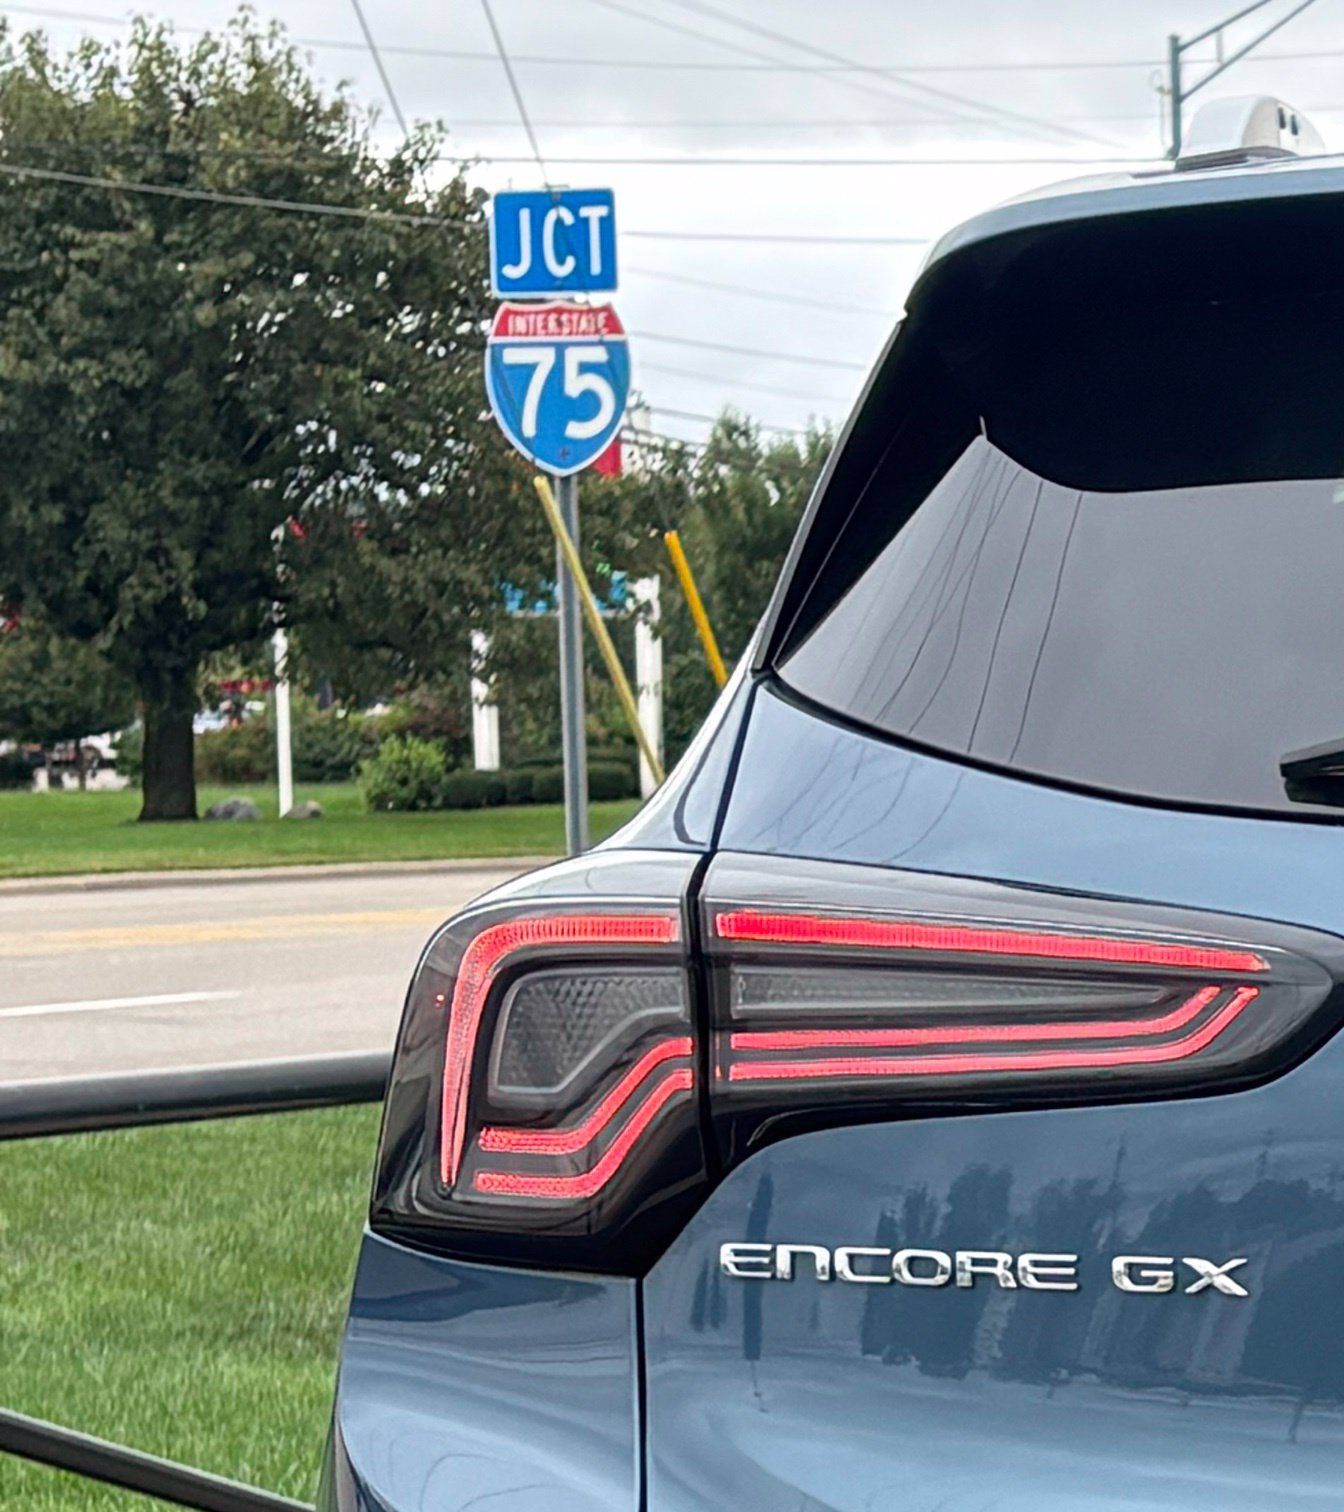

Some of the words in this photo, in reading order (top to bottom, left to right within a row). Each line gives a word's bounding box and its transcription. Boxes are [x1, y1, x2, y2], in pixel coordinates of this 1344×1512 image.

[502, 205, 609, 279] JCT
[507, 311, 609, 336] INTERSTATE
[502, 346, 616, 440] 75
[719, 1242, 1079, 1290] ENCORE
[1111, 1255, 1249, 1296] GX
